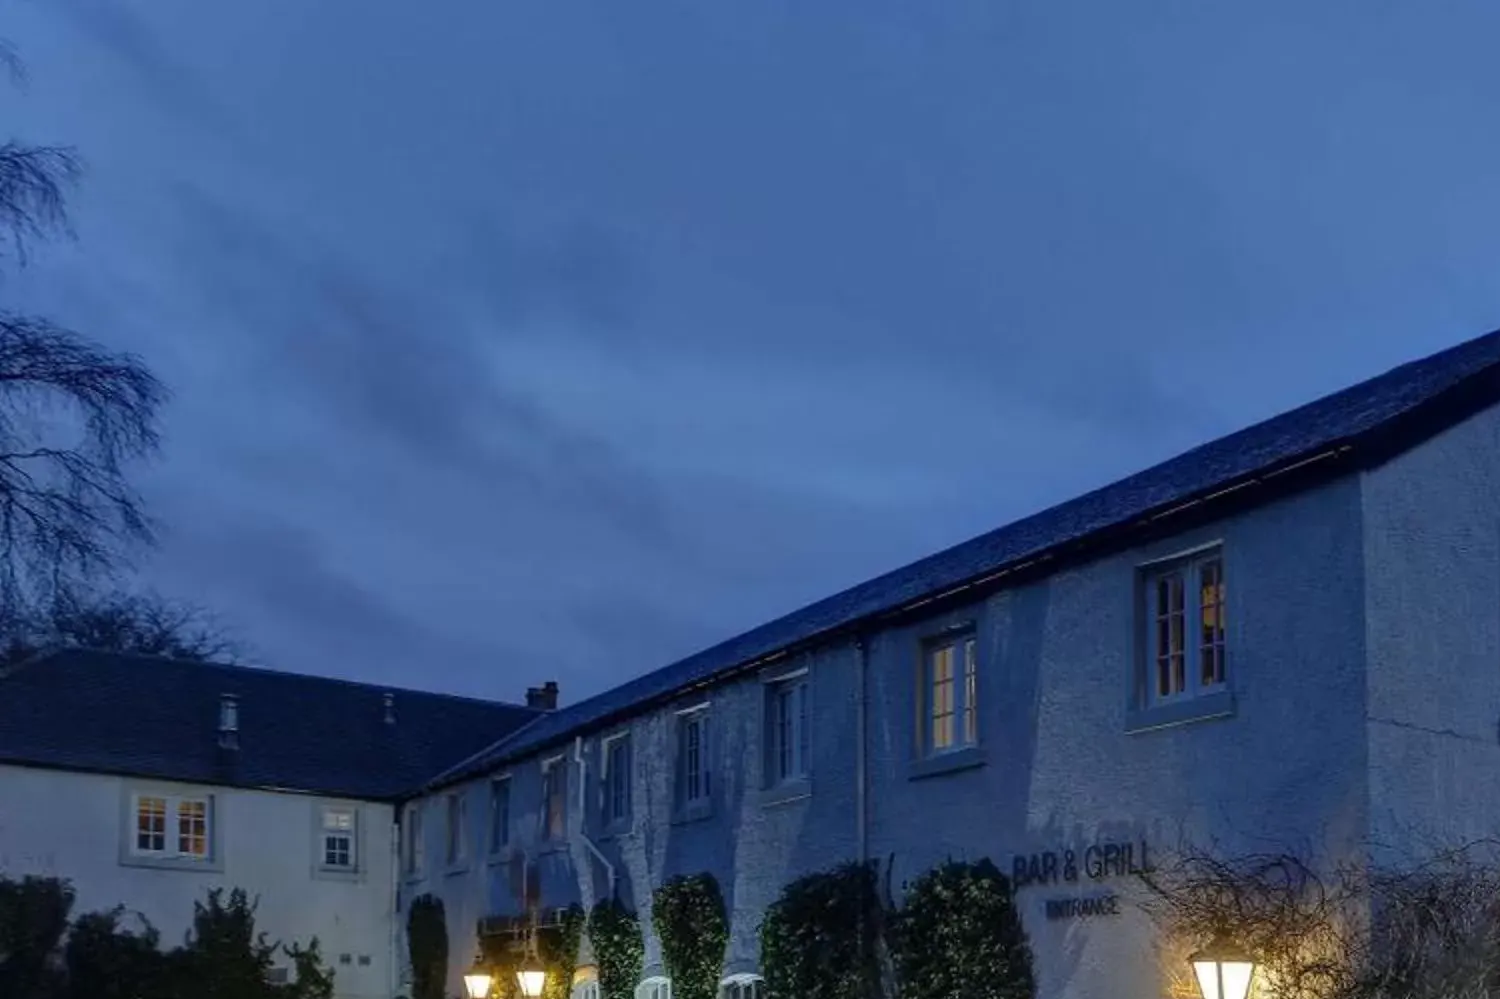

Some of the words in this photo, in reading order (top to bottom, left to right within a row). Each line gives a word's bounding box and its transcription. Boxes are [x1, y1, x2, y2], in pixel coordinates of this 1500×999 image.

[1013, 853, 1058, 886] BAR
[1064, 849, 1078, 881] &
[1085, 840, 1155, 878] GRILL
[1046, 895, 1120, 919] ENTRANCE
